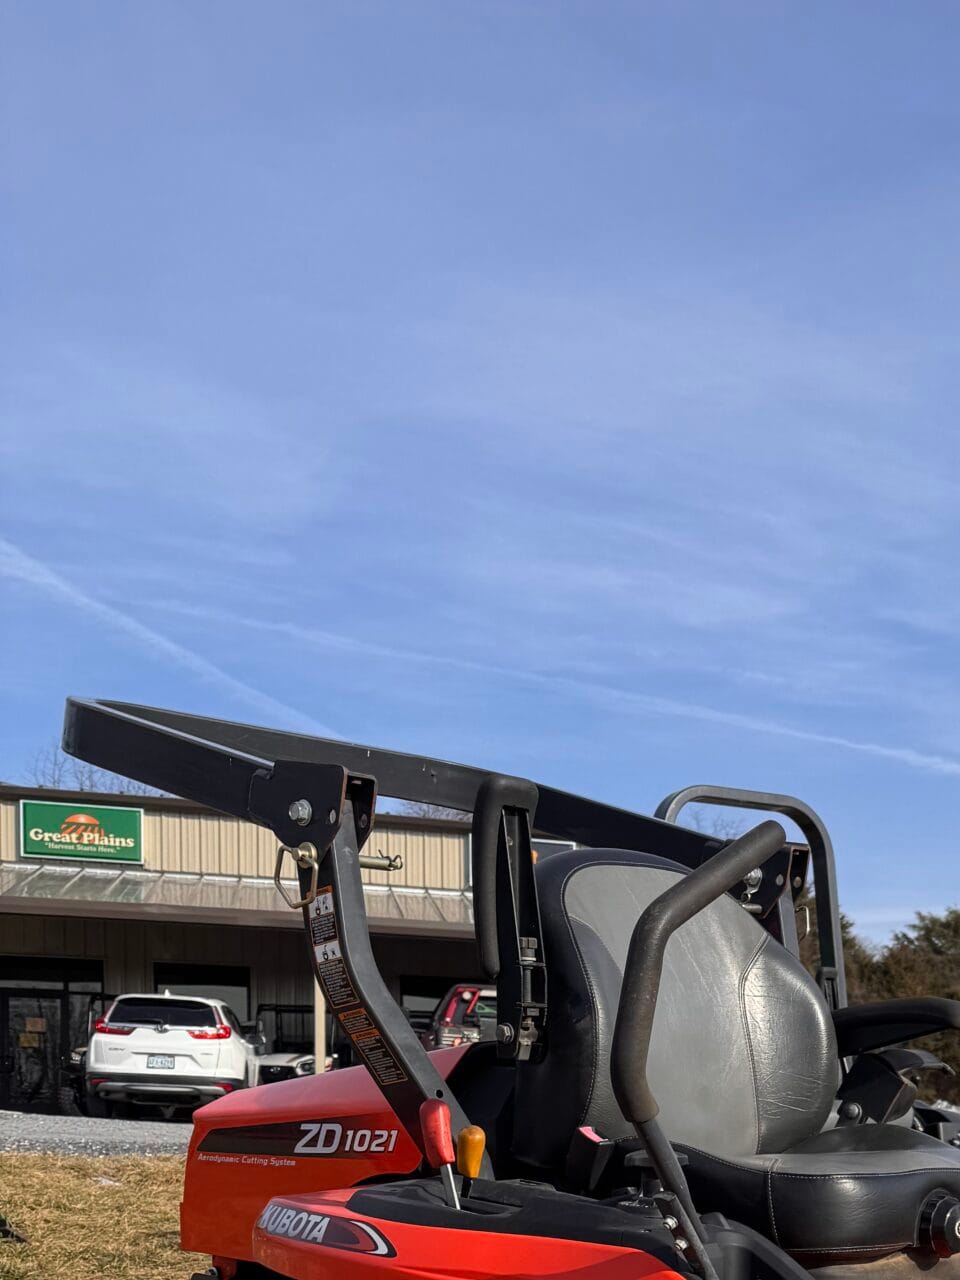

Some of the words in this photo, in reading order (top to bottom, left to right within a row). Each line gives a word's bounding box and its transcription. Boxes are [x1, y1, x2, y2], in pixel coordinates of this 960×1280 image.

[29, 828, 80, 843] Great
[82, 832, 135, 848] Plains
[293, 1123, 343, 1154] ZD
[345, 1129, 399, 1152] 1021
[197, 1153, 240, 1163] Aerodynamic
[241, 1155, 269, 1165] Cutting
[270, 1157, 296, 1167] System
[257, 1204, 331, 1243] KUBOTA
